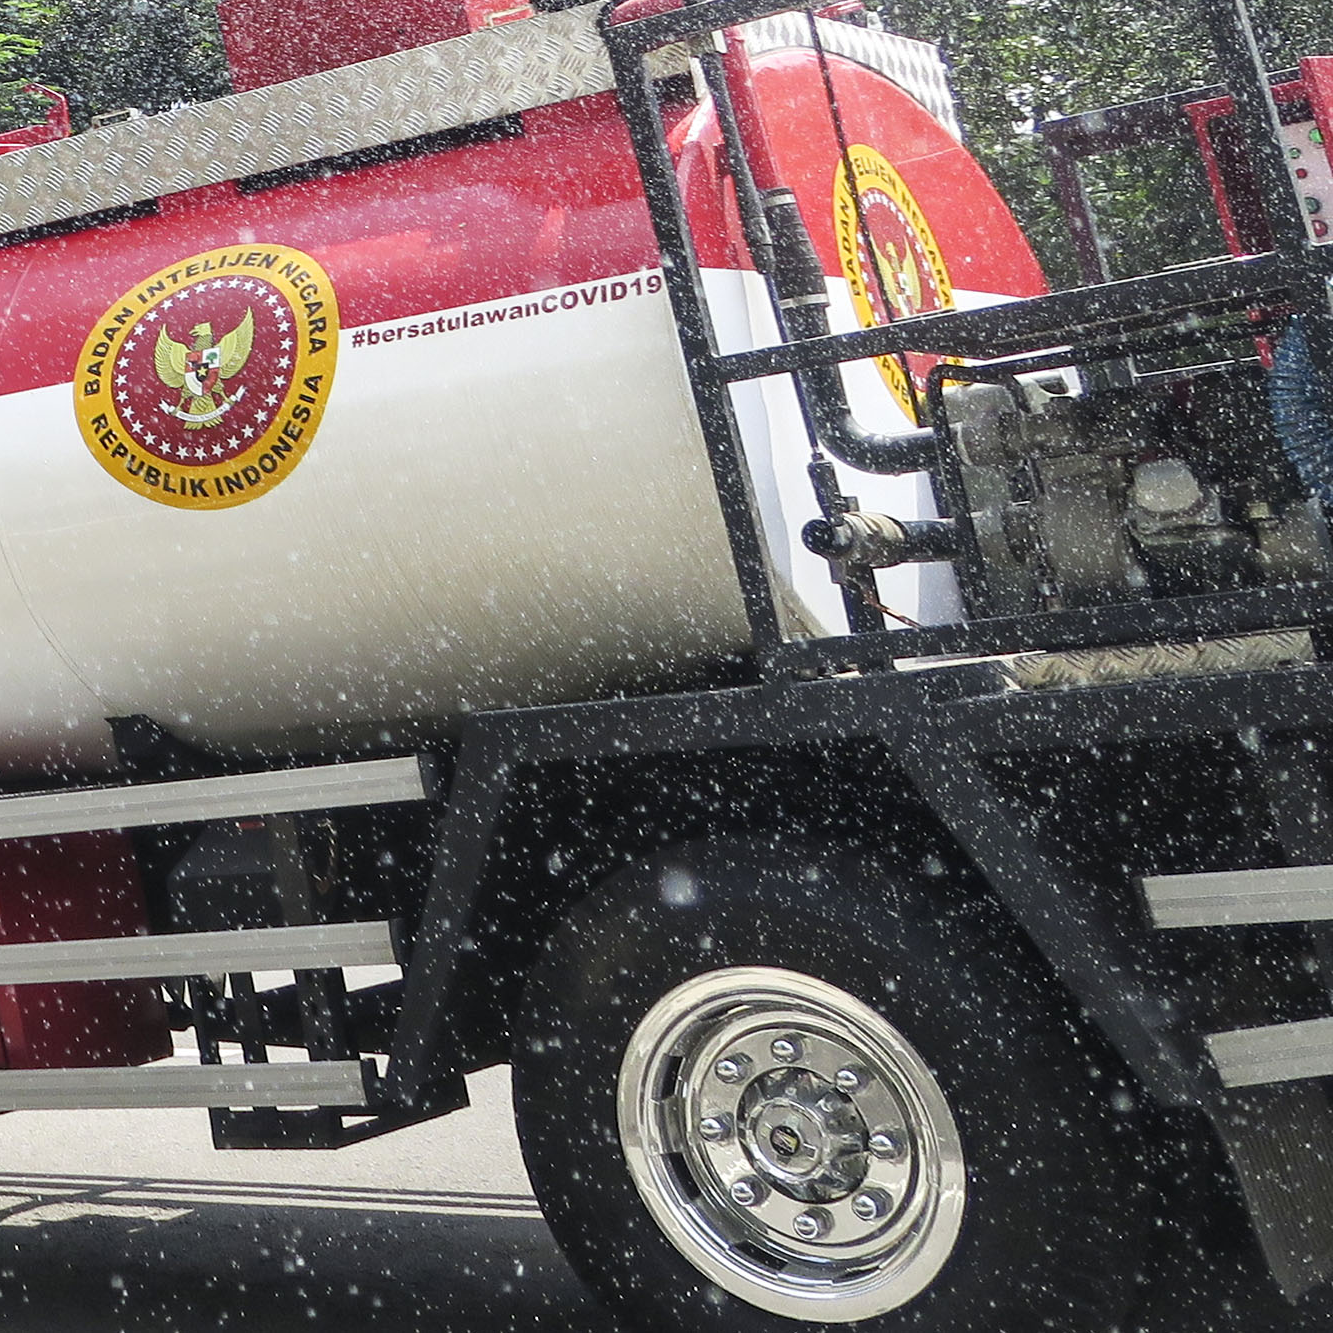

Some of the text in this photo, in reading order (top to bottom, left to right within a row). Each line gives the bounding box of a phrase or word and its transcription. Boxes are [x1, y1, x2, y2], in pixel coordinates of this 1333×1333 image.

[84, 252, 328, 396] BADAN INTELIJEN NEGARA
[351, 273, 662, 348] #bersatulawanCOVID19
[91, 374, 323, 497] REPUBLIK INDONESIA
